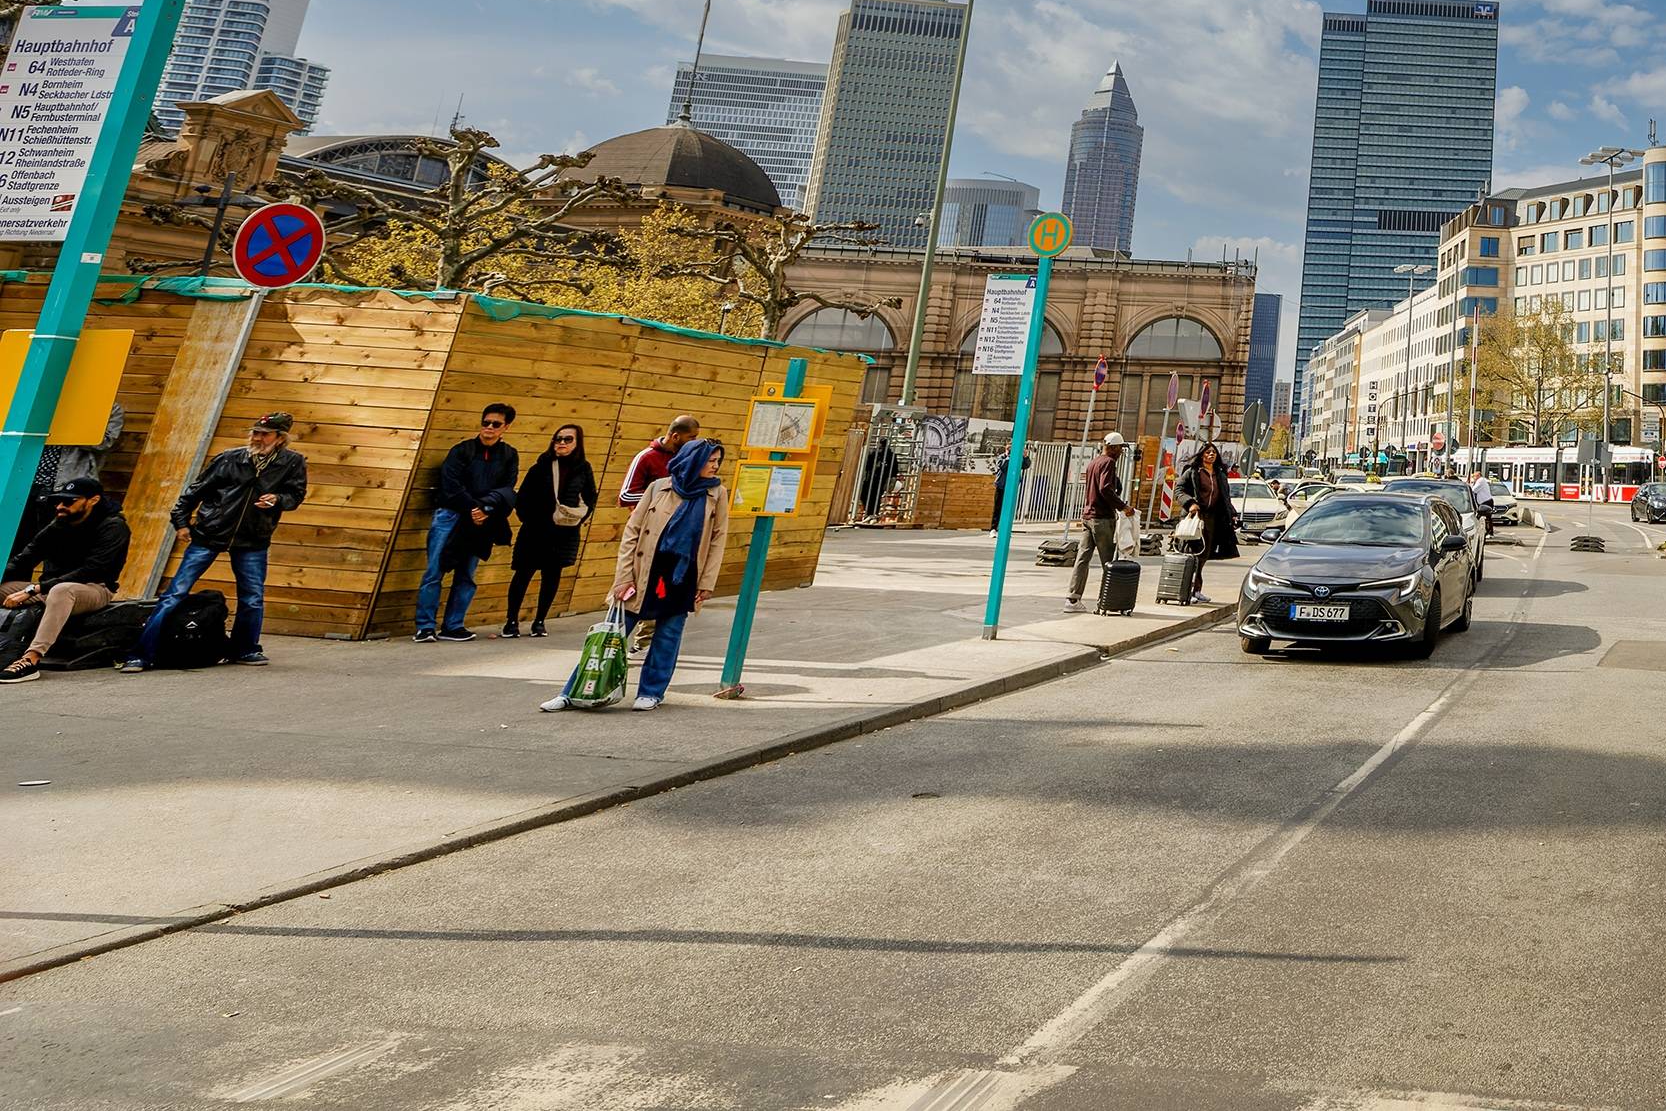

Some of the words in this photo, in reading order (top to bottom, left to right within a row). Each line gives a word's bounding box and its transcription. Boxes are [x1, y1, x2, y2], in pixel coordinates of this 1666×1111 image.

[14, 38, 115, 56] Hauptbahnhof
[28, 60, 47, 74] 64
[49, 57, 95, 66] Westhafen
[18, 82, 39, 97] N4
[41, 79, 84, 89] Bornheim
[38, 89, 88, 100] Seckbacher
[10, 104, 32, 119] N5
[30, 112, 101, 122] Fernbusterminal
[26, 124, 79, 134] Fechenheim
[18, 147, 75, 157] Schwanheim
[14, 158, 86, 168] Rheinlandstraße
[10, 170, 55, 180] Offenbach
[6, 181, 60, 192] Stadtgrenze
[1, 195, 51, 207] Aussteigen
[0, 218, 69, 229] nersatzverkehr
[1041, 221, 1059, 247] H
[986, 288, 1028, 296] Hauptbahnhof
[1366, 381, 1378, 436] HOTEL
